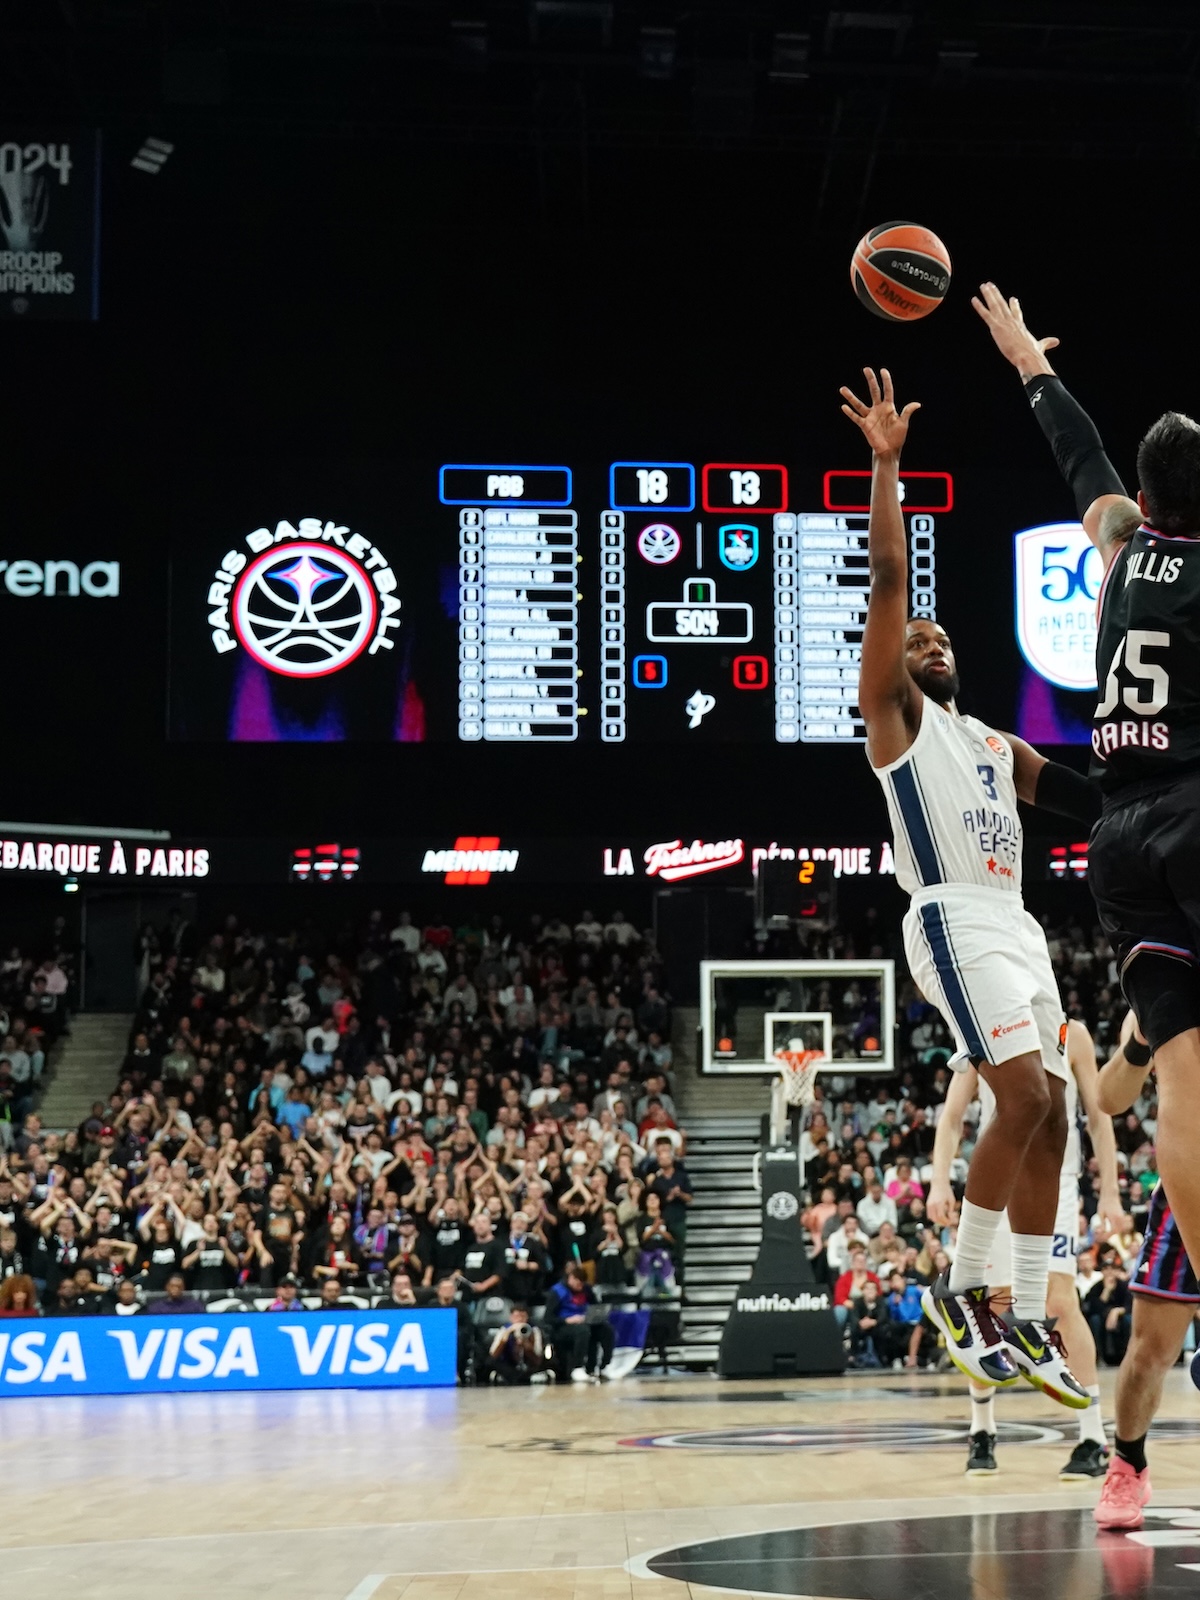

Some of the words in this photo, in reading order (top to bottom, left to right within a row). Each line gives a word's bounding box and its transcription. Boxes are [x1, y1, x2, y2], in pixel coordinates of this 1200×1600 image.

[0, 142, 74, 186] 024
[486, 474, 525, 498] PBB
[636, 469, 669, 504] 18
[729, 470, 761, 505] 13
[207, 549, 247, 654] PARIS
[245, 517, 402, 655] BASKETBALL
[1053, 634, 1095, 653] EFE
[1091, 721, 1170, 761] PARIS
[977, 765, 998, 801] 3
[0, 840, 101, 876] BARQUE
[108, 839, 128, 875] À
[135, 848, 210, 878] PARIS
[421, 849, 520, 873] MENNEN
[603, 848, 635, 876] LA
[0, 1330, 88, 1385] ISA
[106, 1325, 260, 1381] VISA
[277, 1321, 430, 1376] VISA
